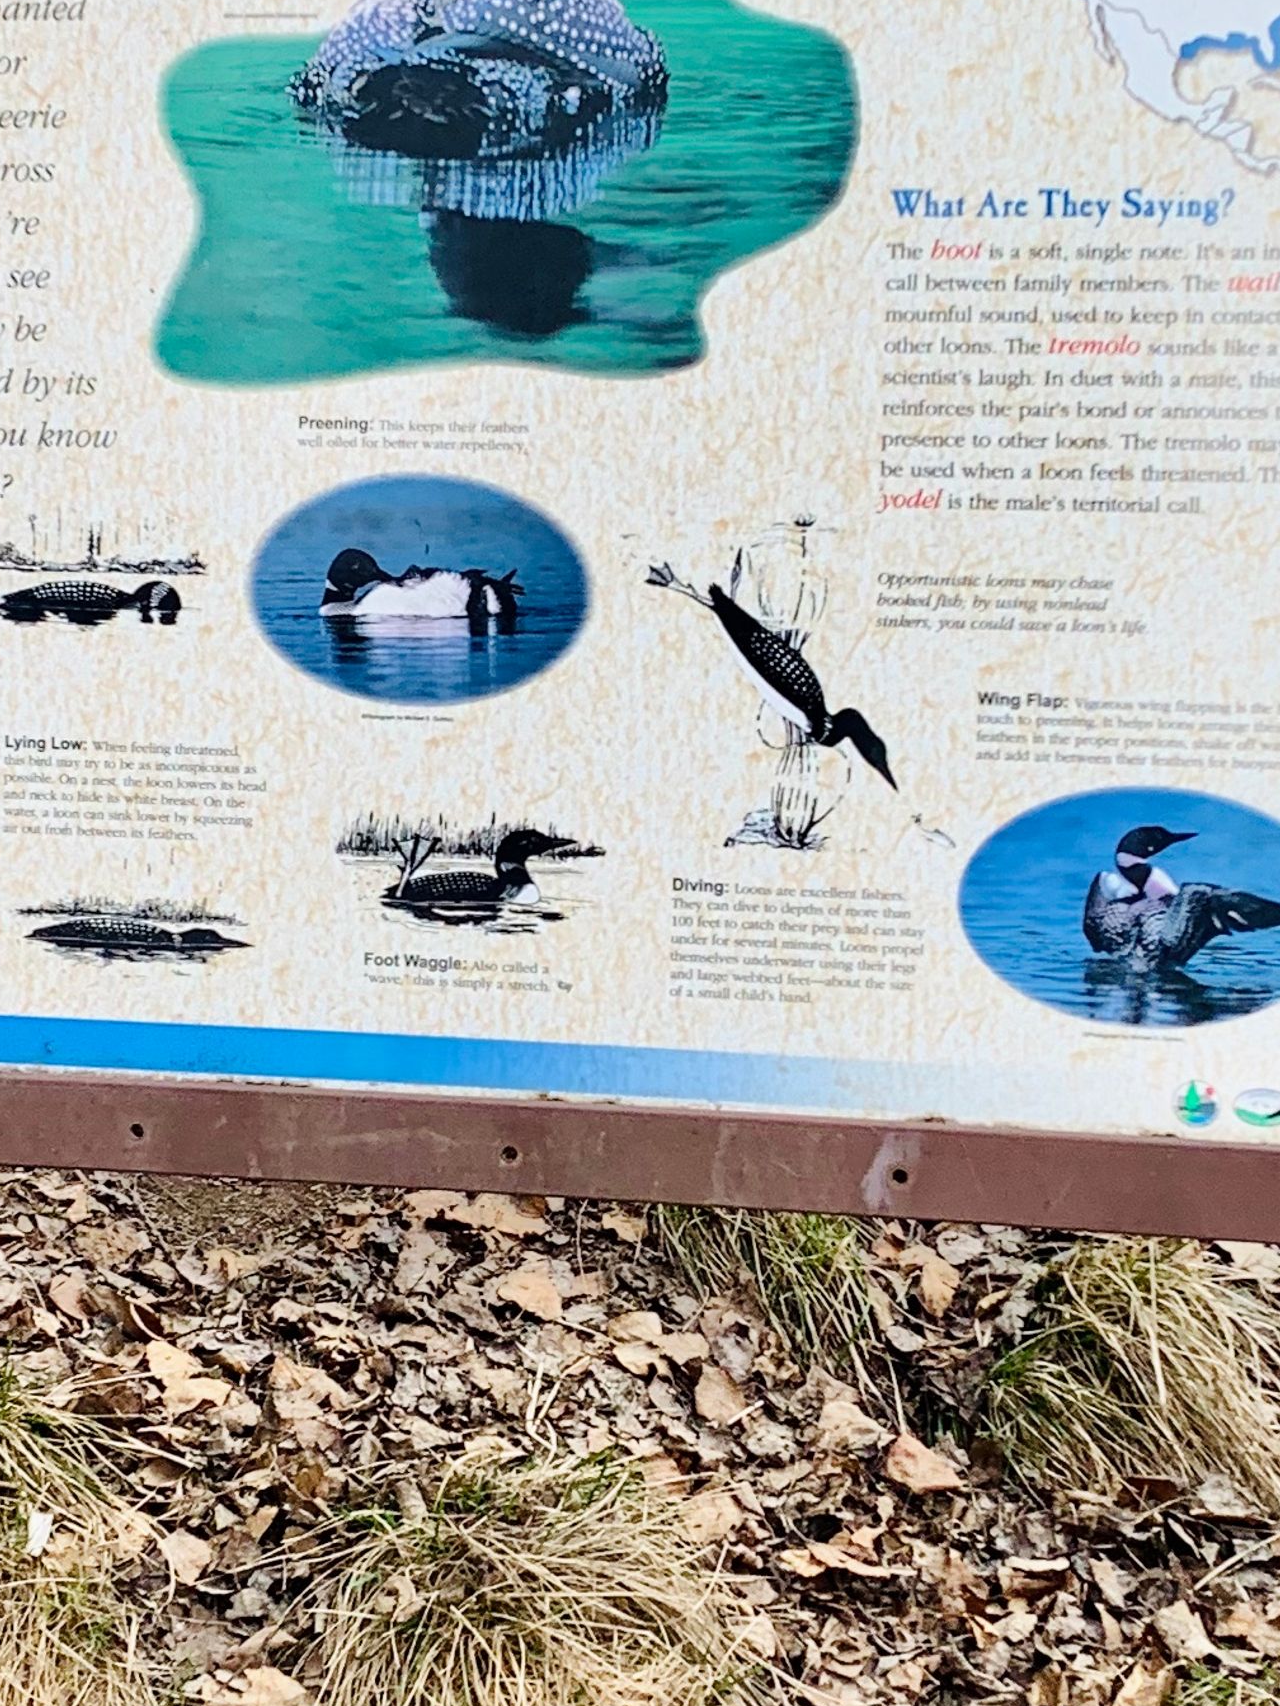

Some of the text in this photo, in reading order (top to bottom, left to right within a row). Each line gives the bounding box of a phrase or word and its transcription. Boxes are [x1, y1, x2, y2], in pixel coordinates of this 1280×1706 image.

[0, 108, 66, 129] eerie
[891, 188, 1235, 227] What Are They Saying?
[886, 243, 923, 260] The
[989, 244, 1003, 260] is
[1011, 248, 1019, 260] a
[1029, 243, 1068, 261] soft,
[1076, 243, 1131, 263] single
[1140, 247, 1188, 260] note.
[1196, 243, 1224, 260] It's
[1232, 248, 1255, 261] an
[8, 270, 50, 289] see
[886, 274, 917, 291] call
[926, 275, 1005, 292] between
[1014, 274, 1072, 296] family
[1080, 275, 1174, 292] members.
[1182, 276, 1220, 292] The
[885, 306, 971, 323] mournful
[979, 307, 1044, 325] sound,
[1051, 307, 1095, 323] used
[1104, 310, 1123, 323] to
[1130, 306, 1178, 328] keep
[1187, 309, 1204, 324] in
[1211, 310, 1280, 325] contact
[15, 316, 47, 342] be
[884, 336, 933, 355] other
[940, 337, 995, 355] loons.
[1005, 337, 1042, 355] The
[1048, 334, 1141, 357] tremolo
[1146, 339, 1215, 357] sounds
[1223, 339, 1259, 357] like
[1267, 344, 1278, 357] a
[23, 369, 55, 401] by
[66, 371, 96, 395] its
[883, 369, 970, 386] scientist's
[979, 369, 1035, 390] laugh.
[1044, 370, 1063, 386] In
[1071, 370, 1113, 387] duet
[1121, 371, 1162, 387] with
[1170, 375, 1180, 387] a
[1189, 373, 1242, 389] mate,
[883, 400, 974, 416] reinforces
[982, 401, 1011, 416] the
[1019, 402, 1069, 420] pair's
[1077, 401, 1126, 417] bond
[1134, 406, 1154, 418] or
[1161, 406, 1268, 420] announces
[38, 422, 117, 448] know
[299, 417, 373, 432] Preening:
[881, 434, 965, 451] presence
[973, 434, 991, 448] to
[998, 432, 1048, 448] other
[1056, 433, 1112, 449] loons.
[1121, 434, 1159, 450] The
[1165, 435, 1241, 451] tremolo
[880, 461, 903, 477] be
[911, 462, 954, 478] used
[962, 463, 1014, 479] when
[1022, 468, 1031, 479] a
[1040, 463, 1082, 479] loon
[1091, 464, 1133, 480] feels
[1142, 466, 1249, 482] threatened.
[877, 489, 943, 513] yodel
[948, 494, 961, 508] is
[970, 494, 998, 509] the
[1006, 495, 1065, 511] male's
[1073, 496, 1159, 512] territorial
[978, 692, 1068, 709] Wing Flap:
[5, 735, 87, 752] Lying Low:
[673, 878, 729, 896] Diving:
[364, 952, 468, 972] Foot Waggle:
